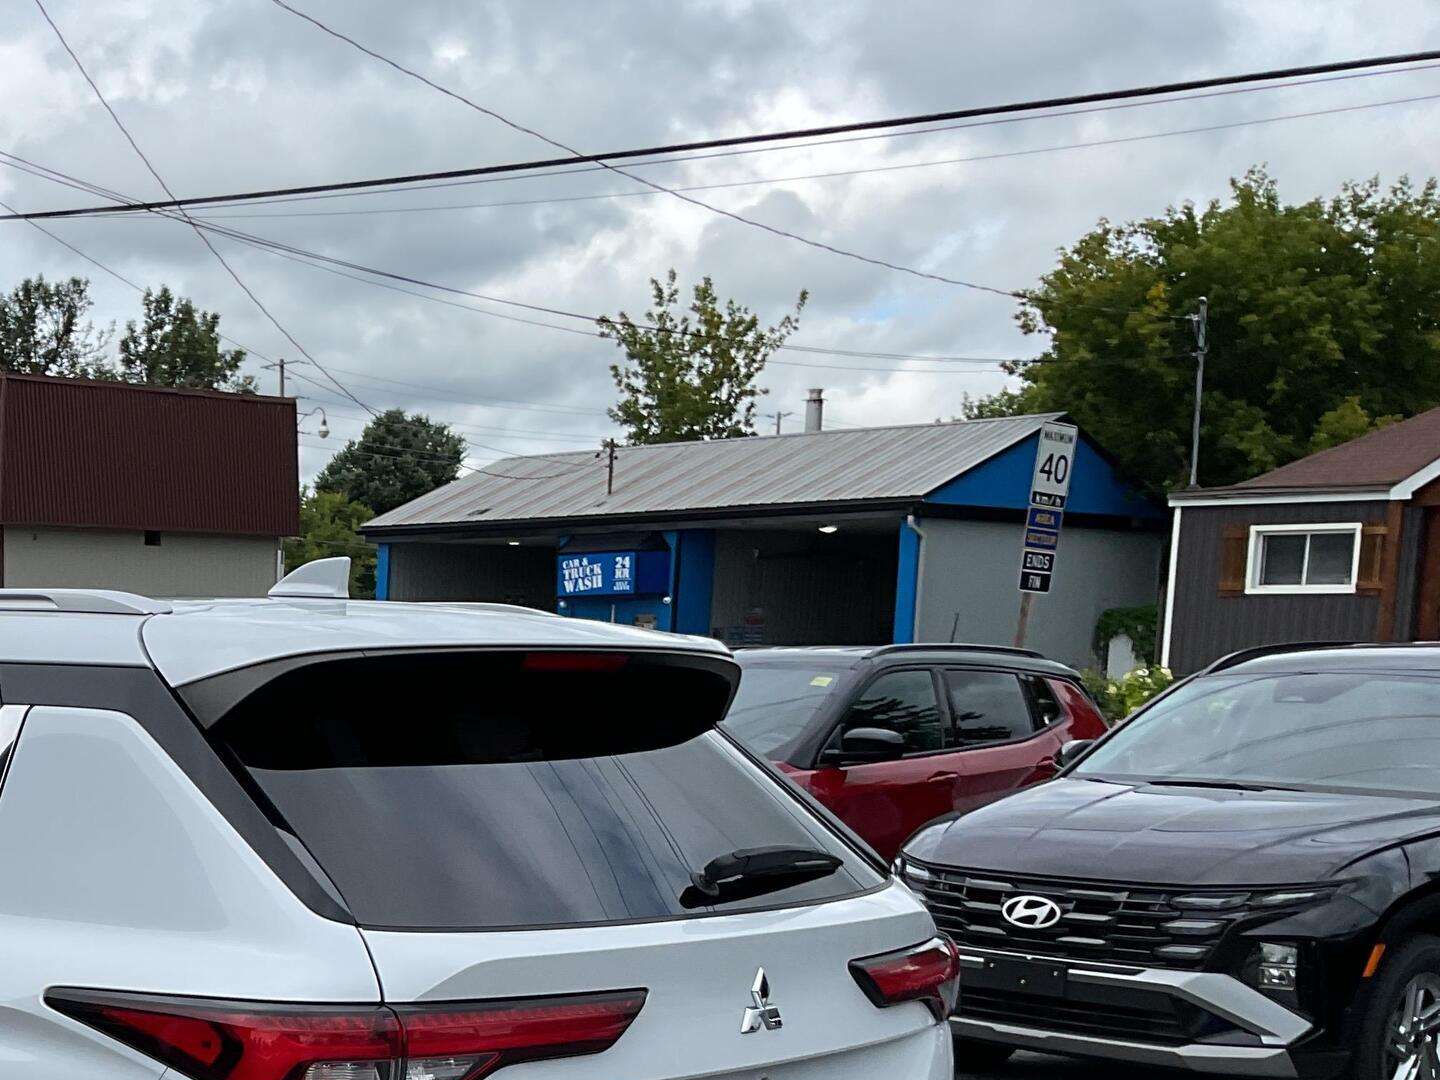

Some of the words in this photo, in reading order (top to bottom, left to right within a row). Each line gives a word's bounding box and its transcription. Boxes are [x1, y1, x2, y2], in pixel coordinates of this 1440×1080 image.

[1040, 453, 1068, 484] 40
[563, 559, 580, 570] CAR
[615, 556, 630, 569] 24
[1026, 554, 1050, 569] ENDS
[563, 562, 602, 580] TRUCK
[564, 575, 602, 593] WASH
[1028, 575, 1041, 589] FIN
